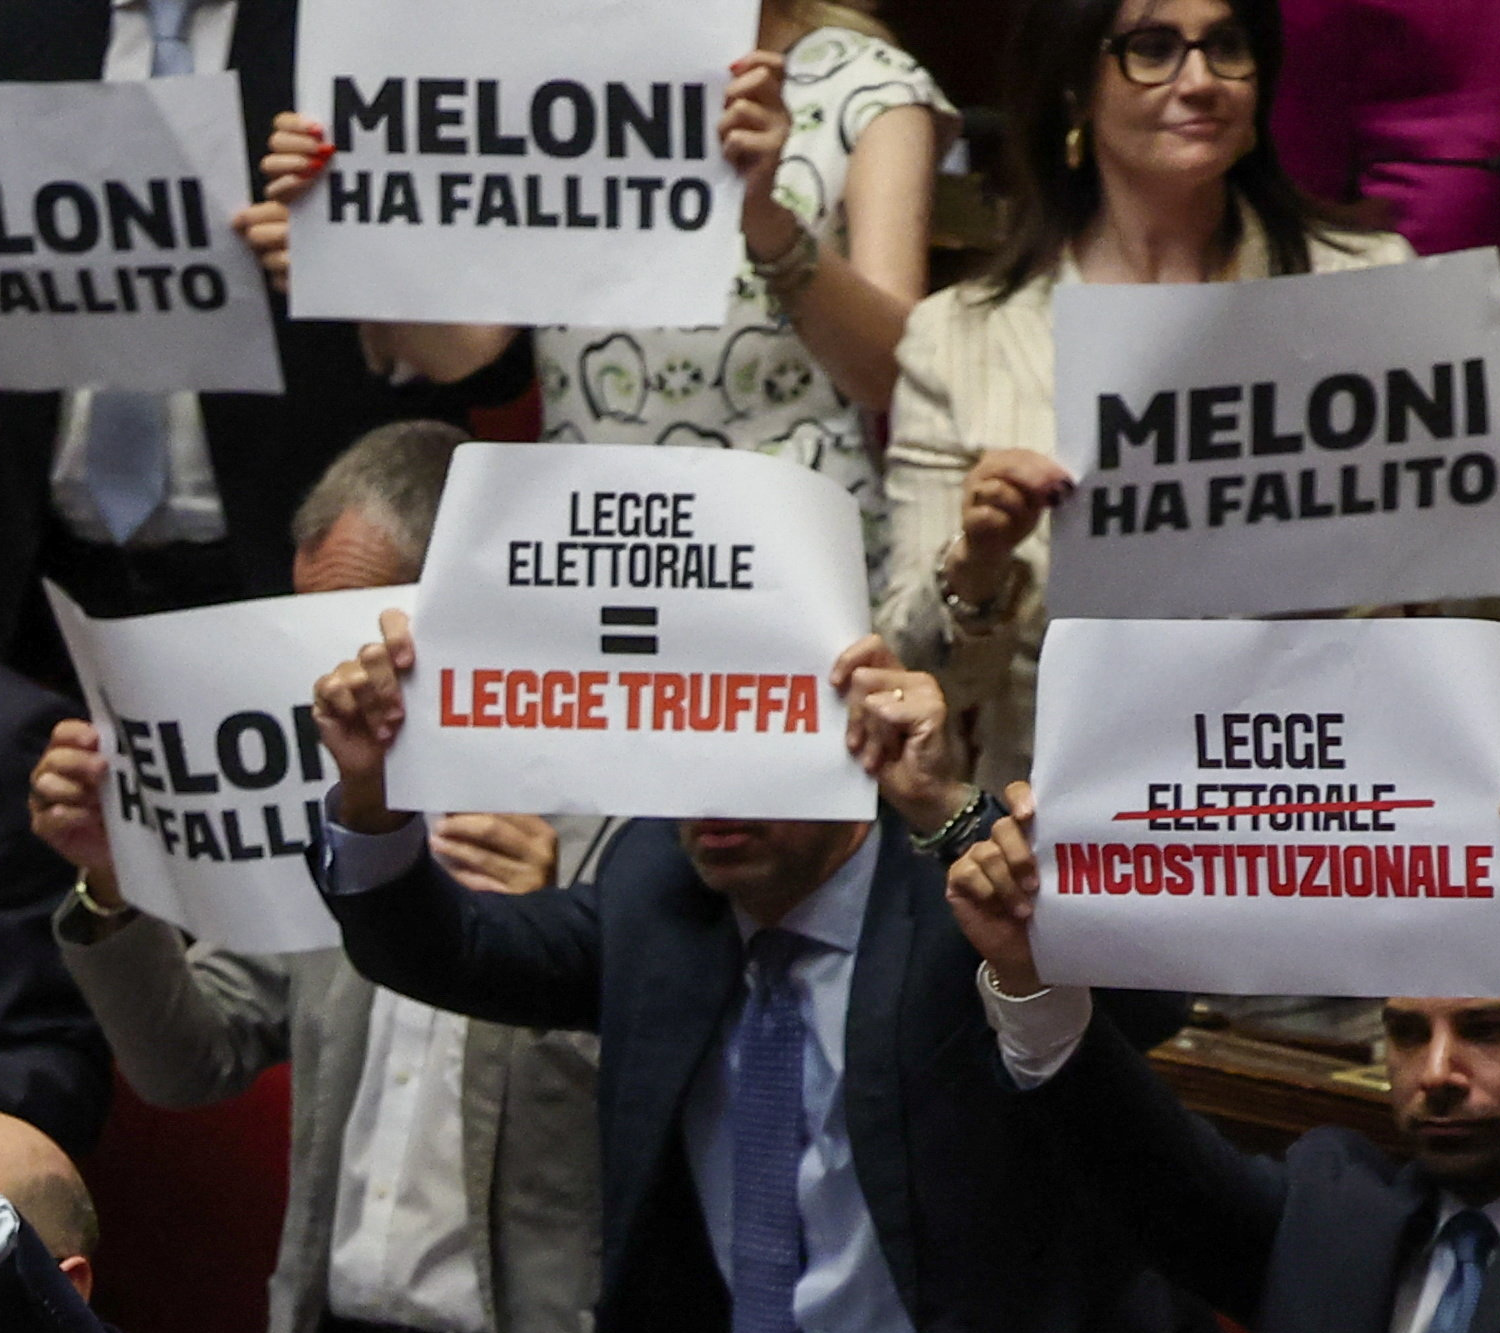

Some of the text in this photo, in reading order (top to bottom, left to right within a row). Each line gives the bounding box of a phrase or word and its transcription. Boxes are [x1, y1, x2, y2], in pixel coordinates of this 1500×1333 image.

[332, 77, 708, 161] MELONI
[327, 170, 712, 233] HA FALLITO
[1098, 359, 1488, 471] MELONI
[569, 492, 696, 539] LEGGE
[1090, 452, 1498, 538] HA FALLITO
[508, 542, 754, 590] ELETTORALE
[440, 668, 819, 735] LEGGE TRUFFA
[116, 703, 323, 792] ELO
[1194, 713, 1345, 770] LEGGE
[155, 799, 323, 862] FALLI
[1147, 783, 1396, 832] ELETTORALE
[1055, 842, 1494, 899] INCOSTITUZIONALE
